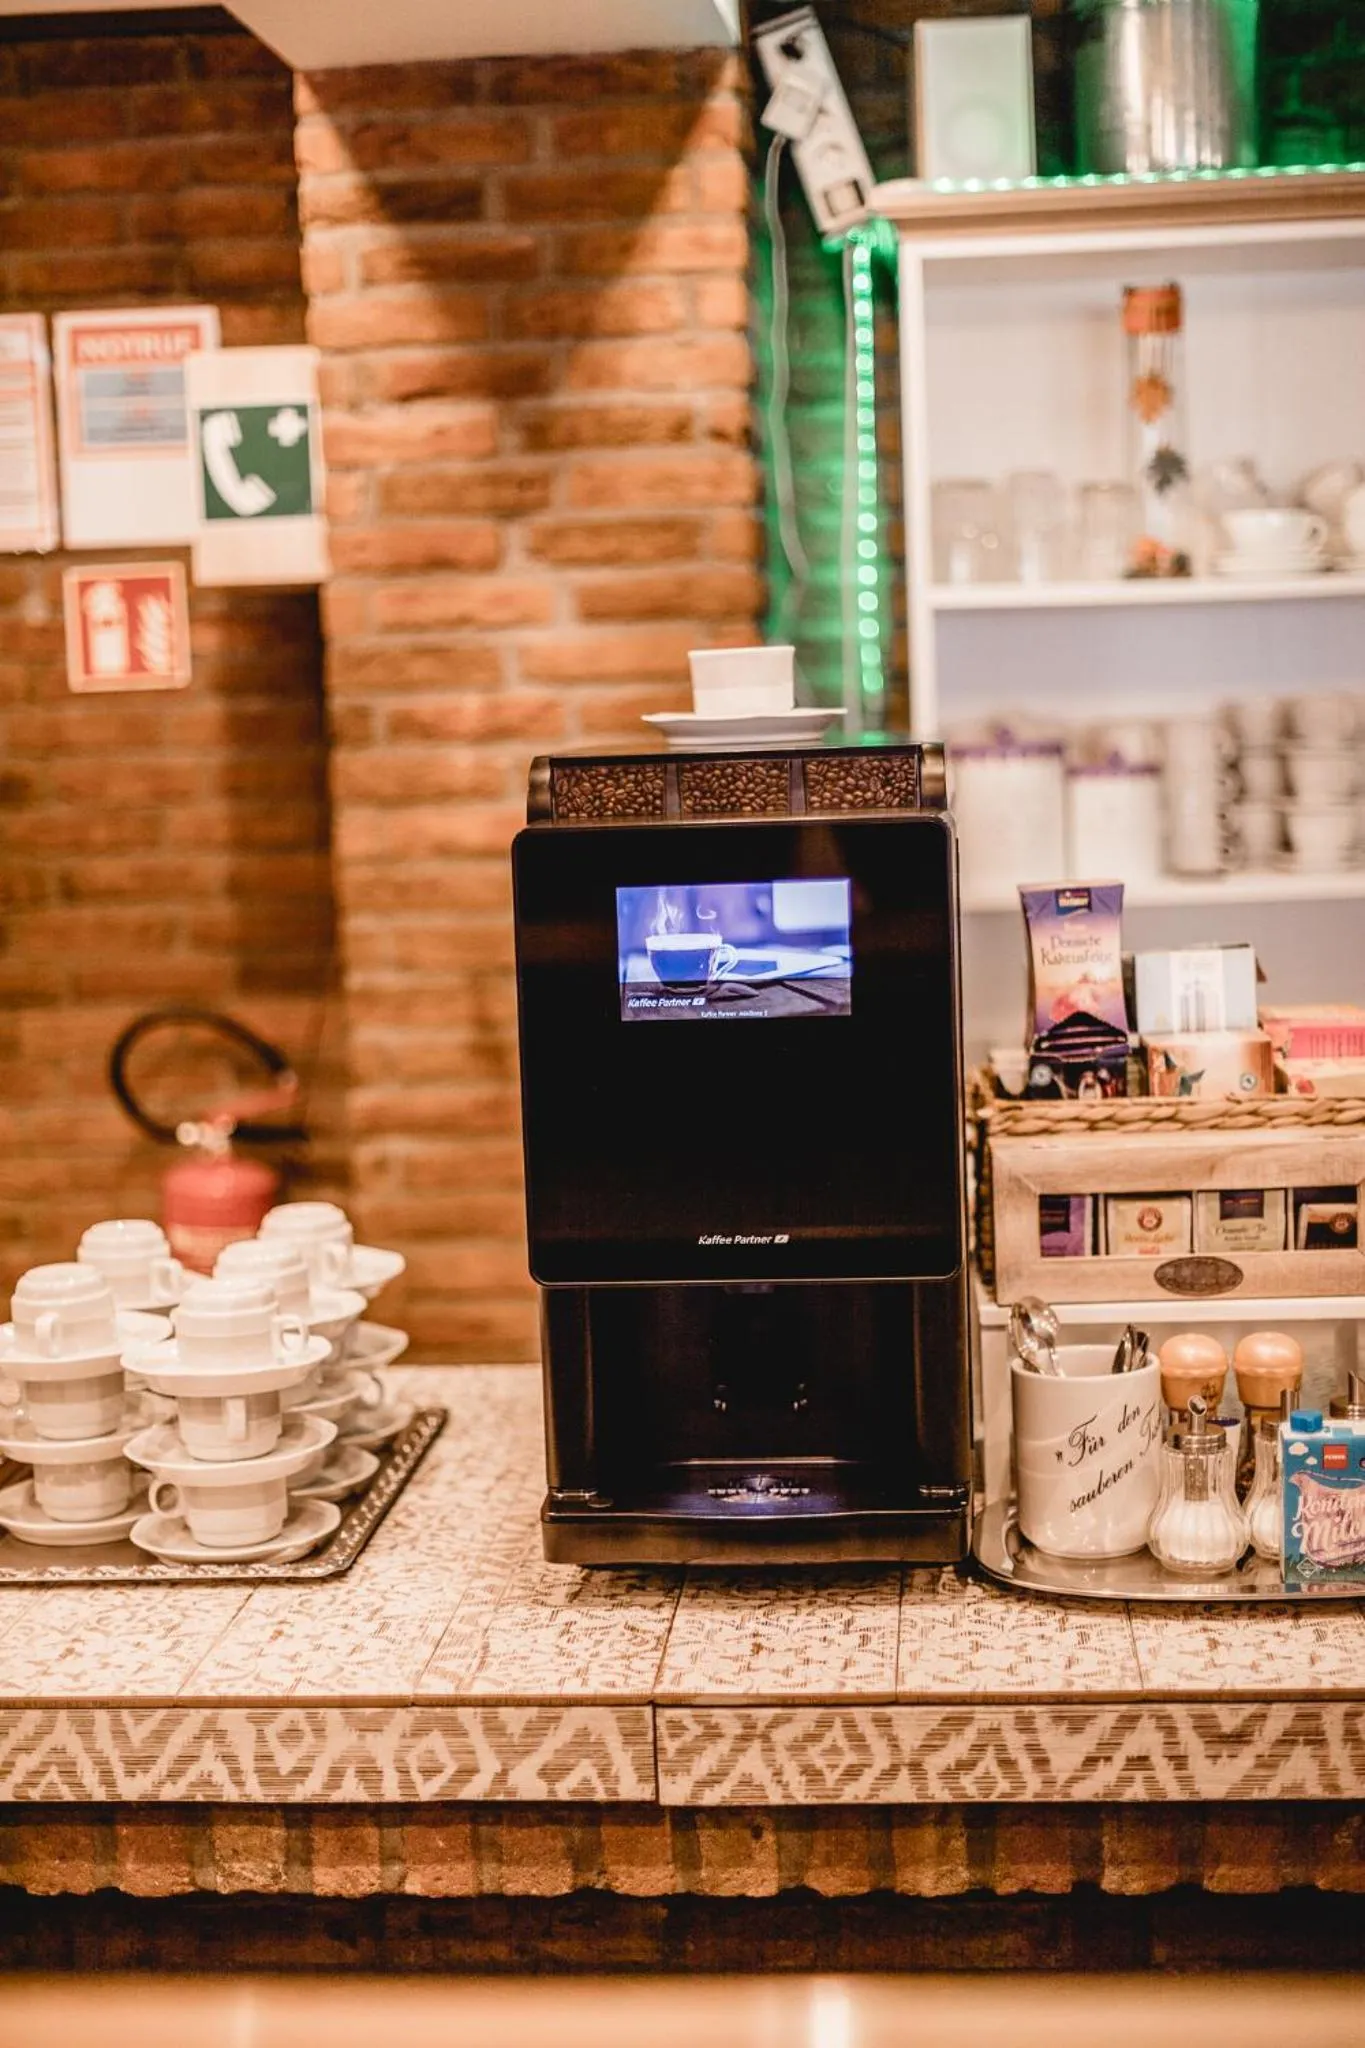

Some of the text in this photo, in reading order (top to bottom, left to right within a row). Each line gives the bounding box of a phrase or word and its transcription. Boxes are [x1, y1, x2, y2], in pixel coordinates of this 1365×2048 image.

[627, 997, 691, 1009] Kaffee Partner
[698, 1234, 773, 1245] Kaffee Partner
[1117, 1403, 1141, 1433] den
[1069, 1459, 1134, 1513] sauberen
